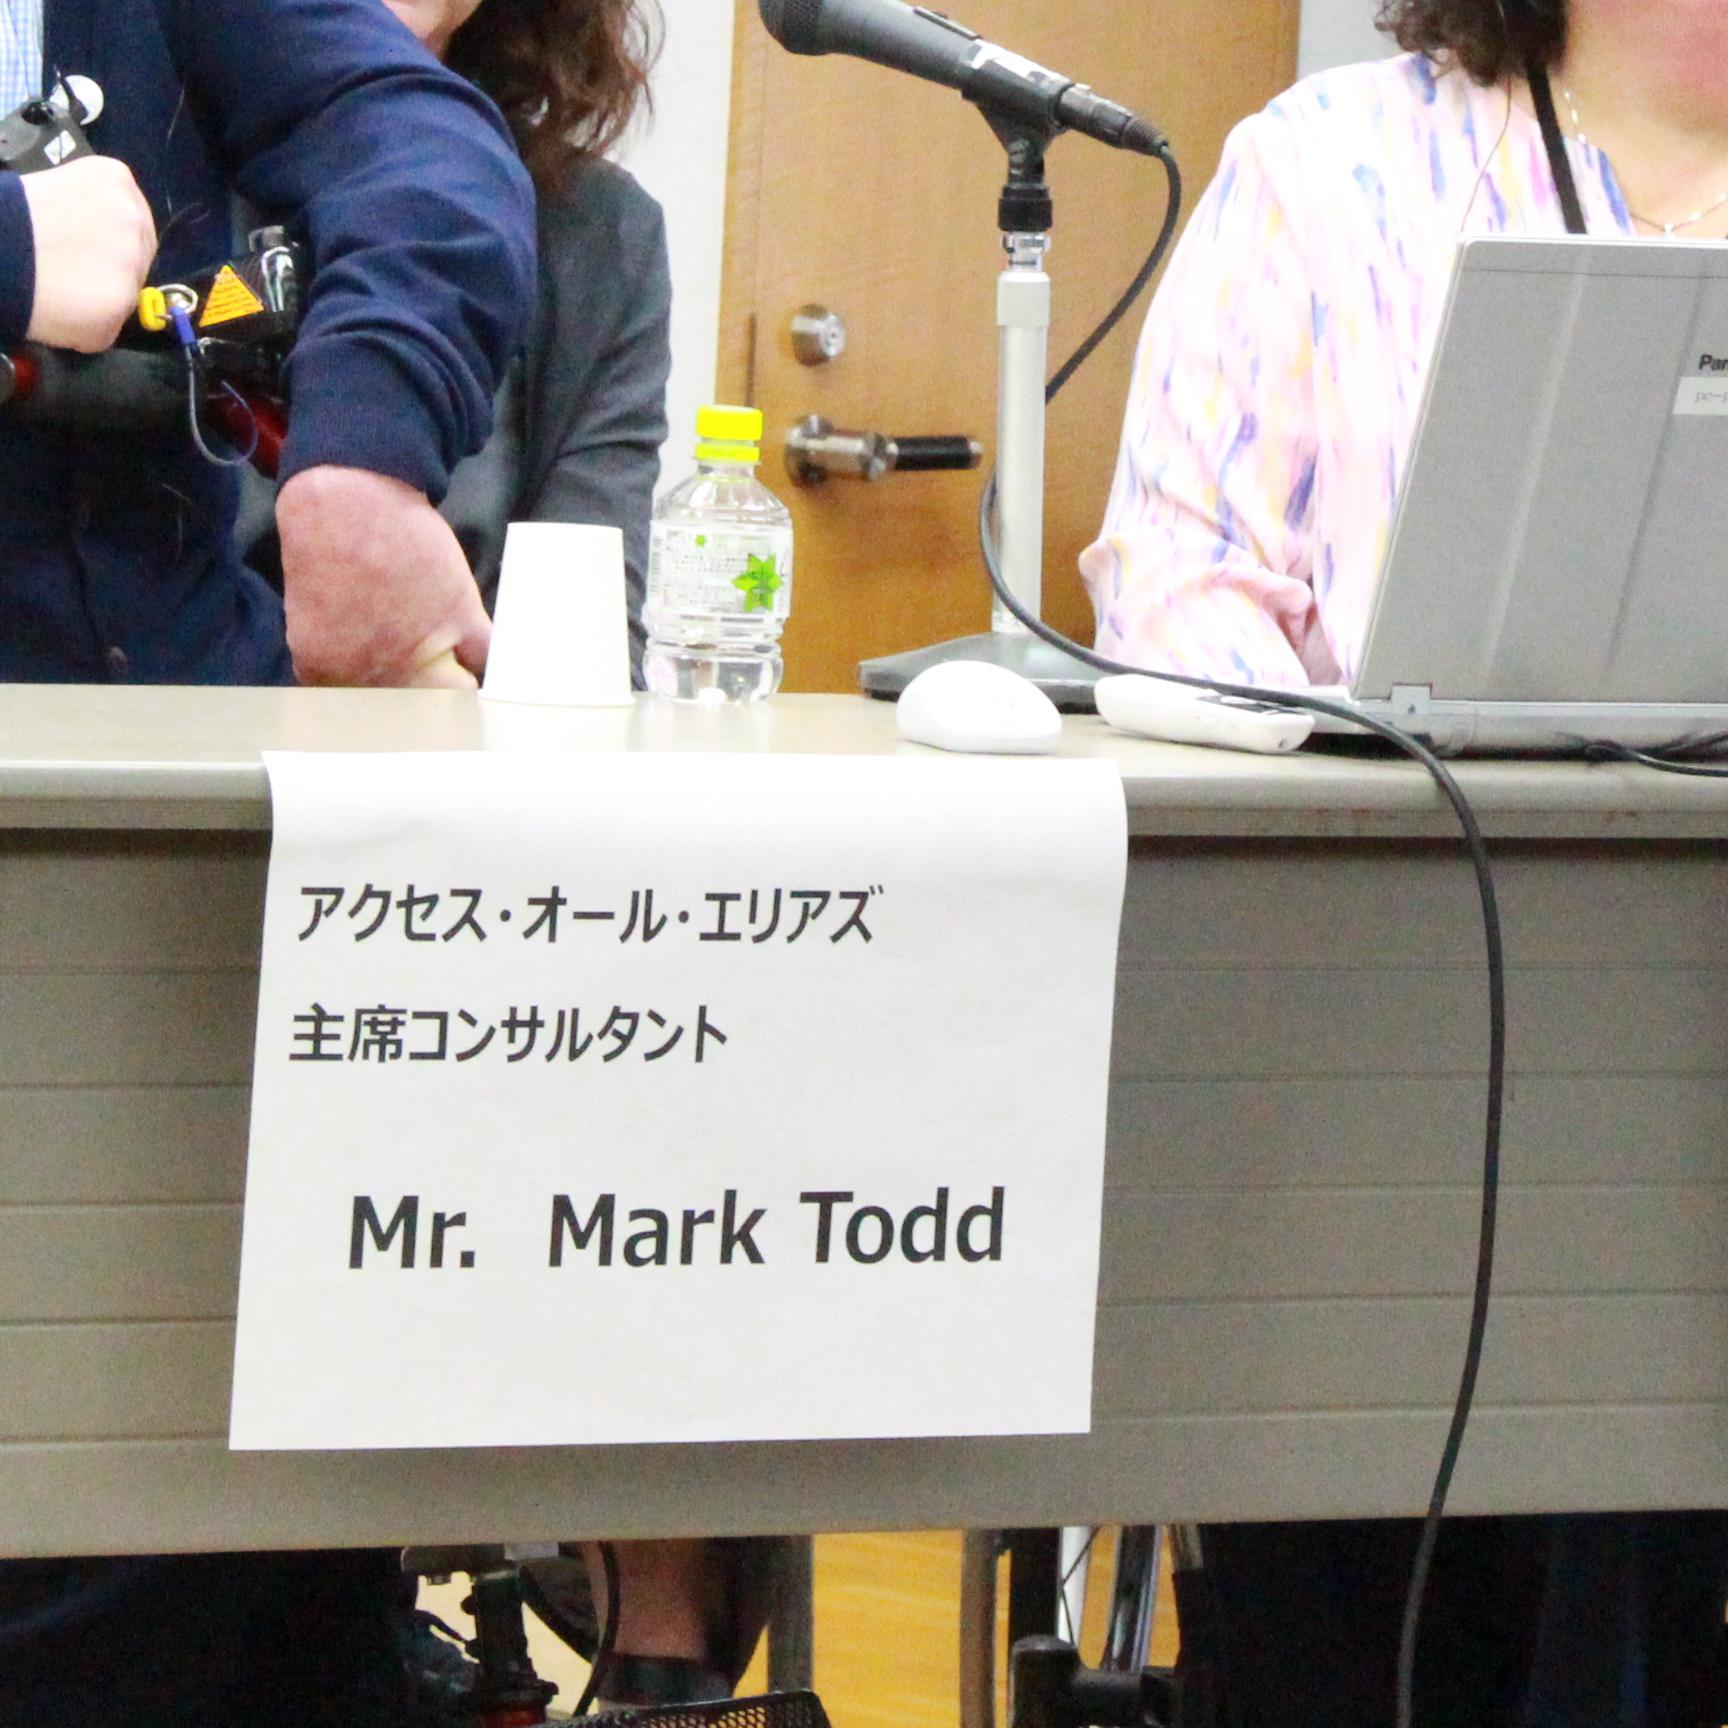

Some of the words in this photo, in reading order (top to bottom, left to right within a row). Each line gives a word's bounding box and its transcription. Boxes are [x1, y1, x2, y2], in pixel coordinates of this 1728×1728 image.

[289, 1003, 728, 1063] 主席コンサルタント
[349, 1195, 475, 1269] Mr.
[549, 1189, 766, 1268] Mark
[799, 1186, 1005, 1264] Todd
